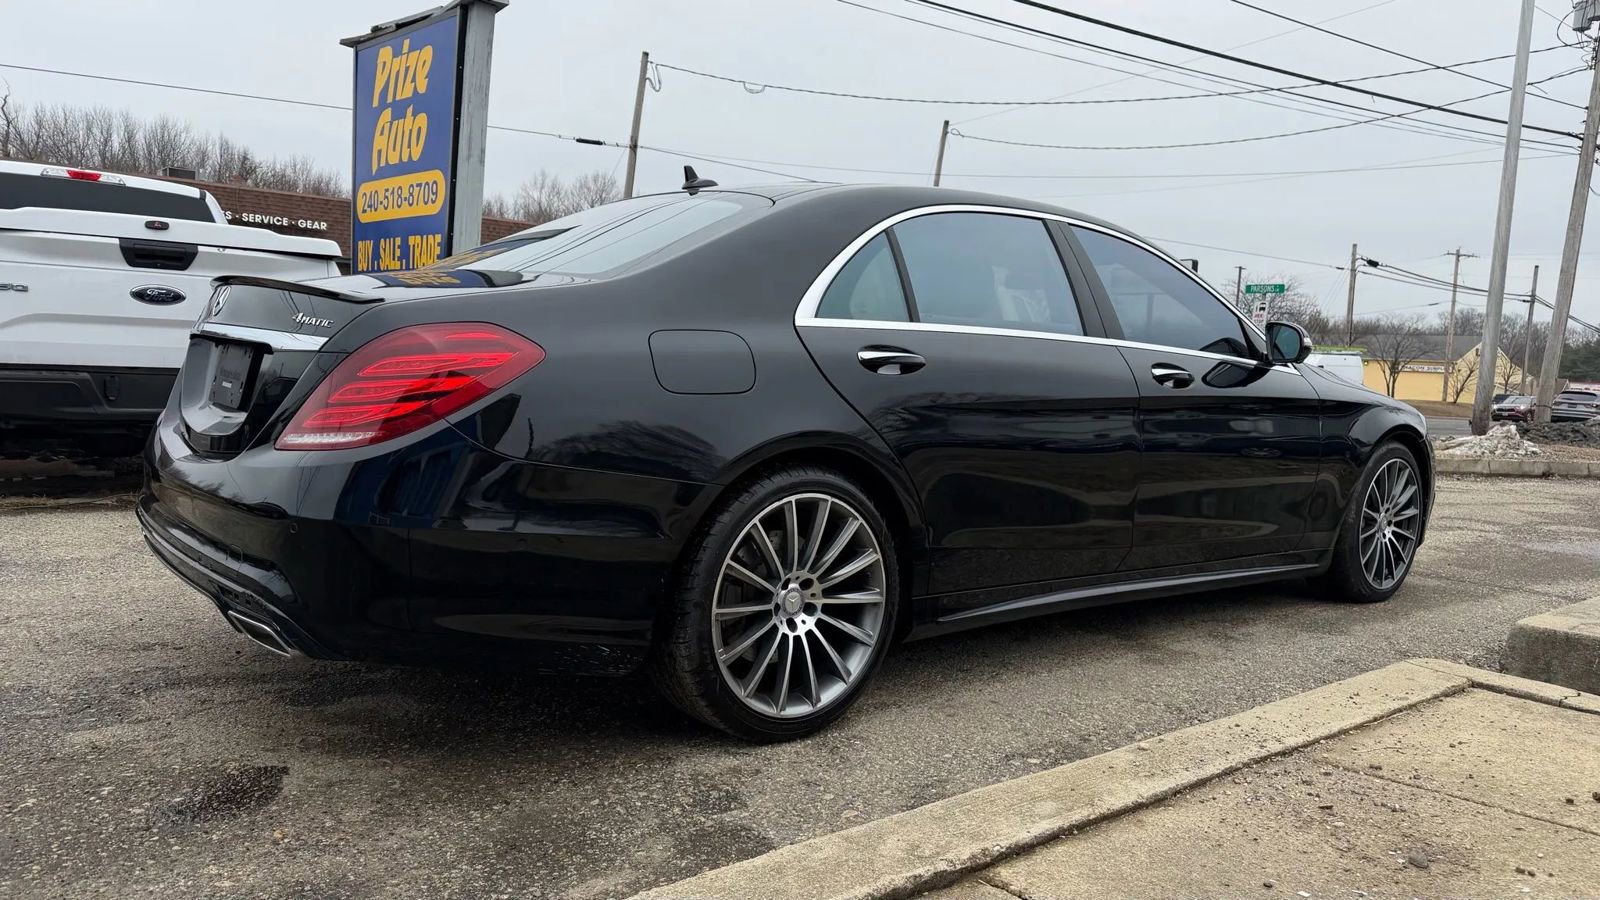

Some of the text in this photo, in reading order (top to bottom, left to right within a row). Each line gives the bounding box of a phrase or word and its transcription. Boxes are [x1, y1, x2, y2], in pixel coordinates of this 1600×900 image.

[372, 38, 433, 108] Prize
[371, 104, 428, 176] Auto
[361, 180, 439, 214] 240-518-8709
[241, 213, 289, 226] SERVICE
[297, 219, 328, 231] GEAR
[408, 232, 442, 270] TRADE
[1250, 285, 1275, 293] PARSONS
